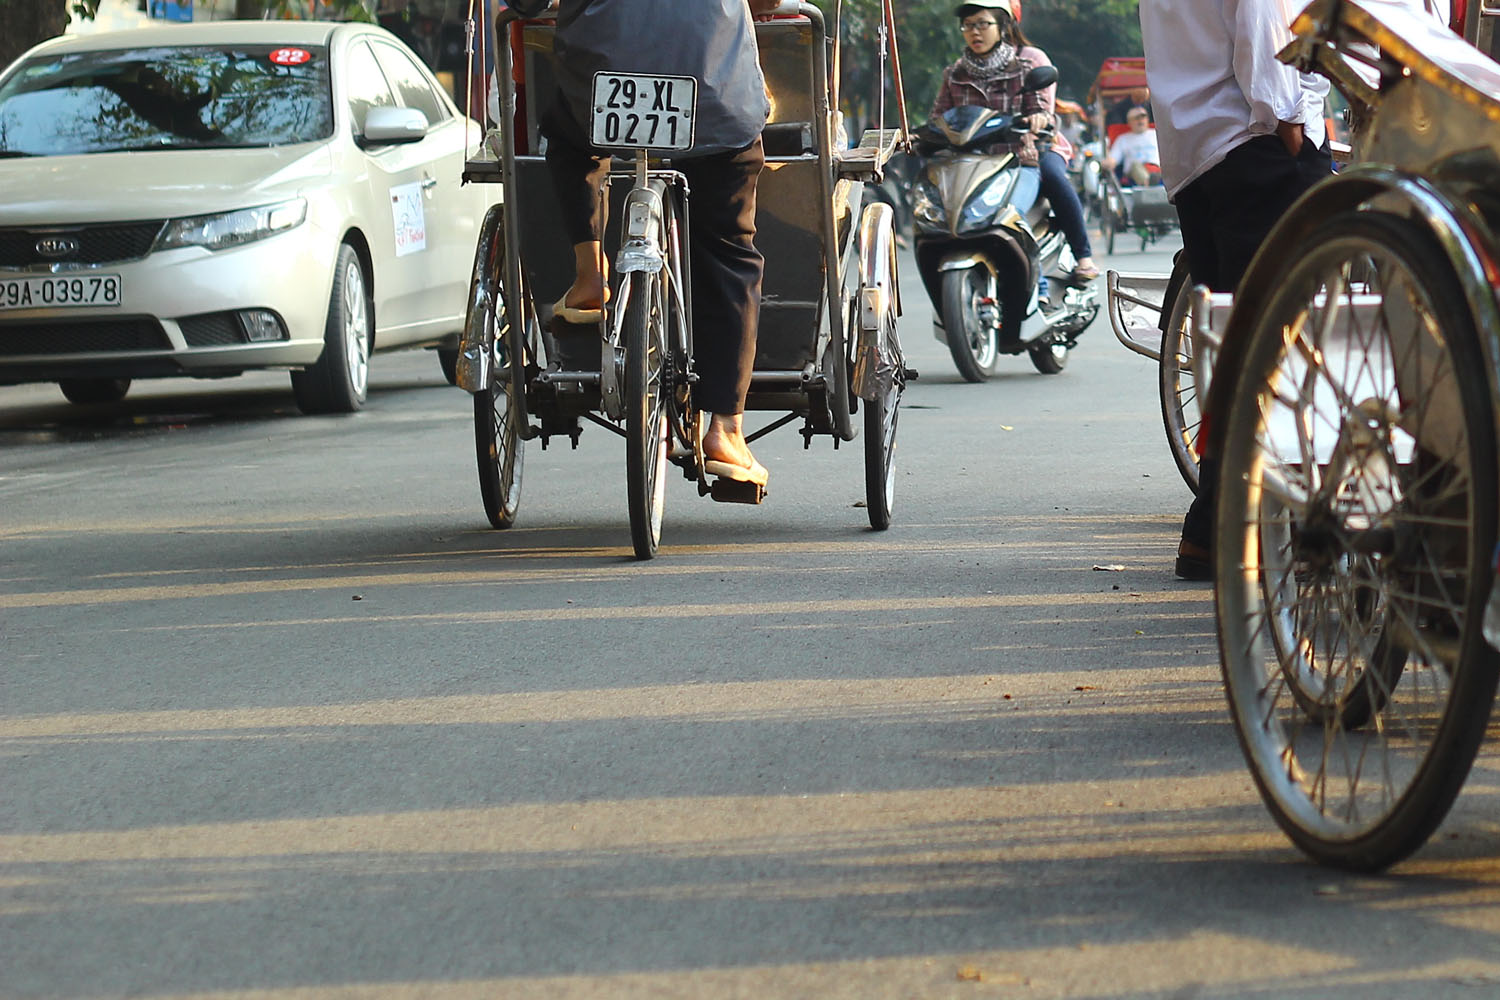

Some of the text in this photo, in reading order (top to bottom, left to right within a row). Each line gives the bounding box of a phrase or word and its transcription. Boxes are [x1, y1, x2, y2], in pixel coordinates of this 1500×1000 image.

[276, 49, 304, 63] 22
[607, 78, 680, 112] 29-XL
[605, 112, 677, 146] 0271
